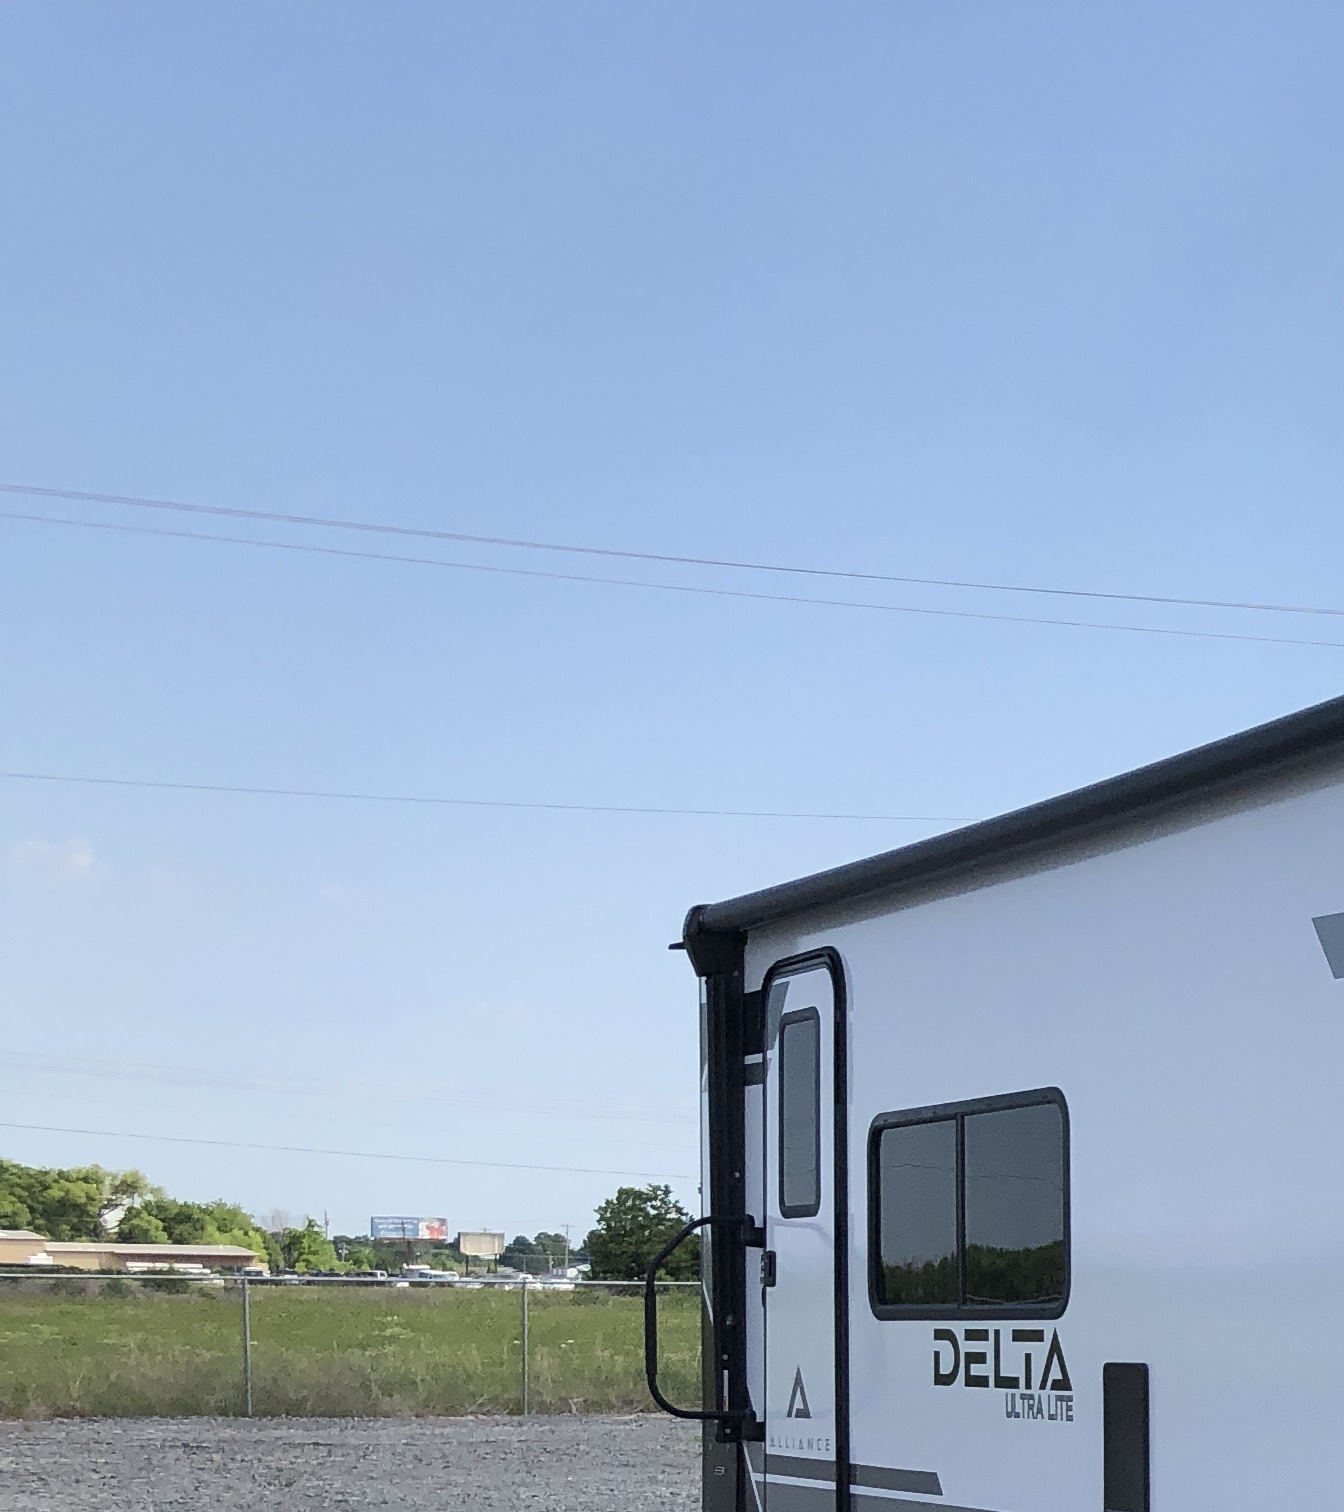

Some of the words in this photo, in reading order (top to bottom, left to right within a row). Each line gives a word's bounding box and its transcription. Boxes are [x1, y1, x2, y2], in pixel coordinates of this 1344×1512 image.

[933, 1327, 1073, 1391] DELTA
[1005, 1392, 1045, 1420] ULTRA
[1047, 1394, 1074, 1422] LITE
[769, 1436, 831, 1452] ALLIANCE
